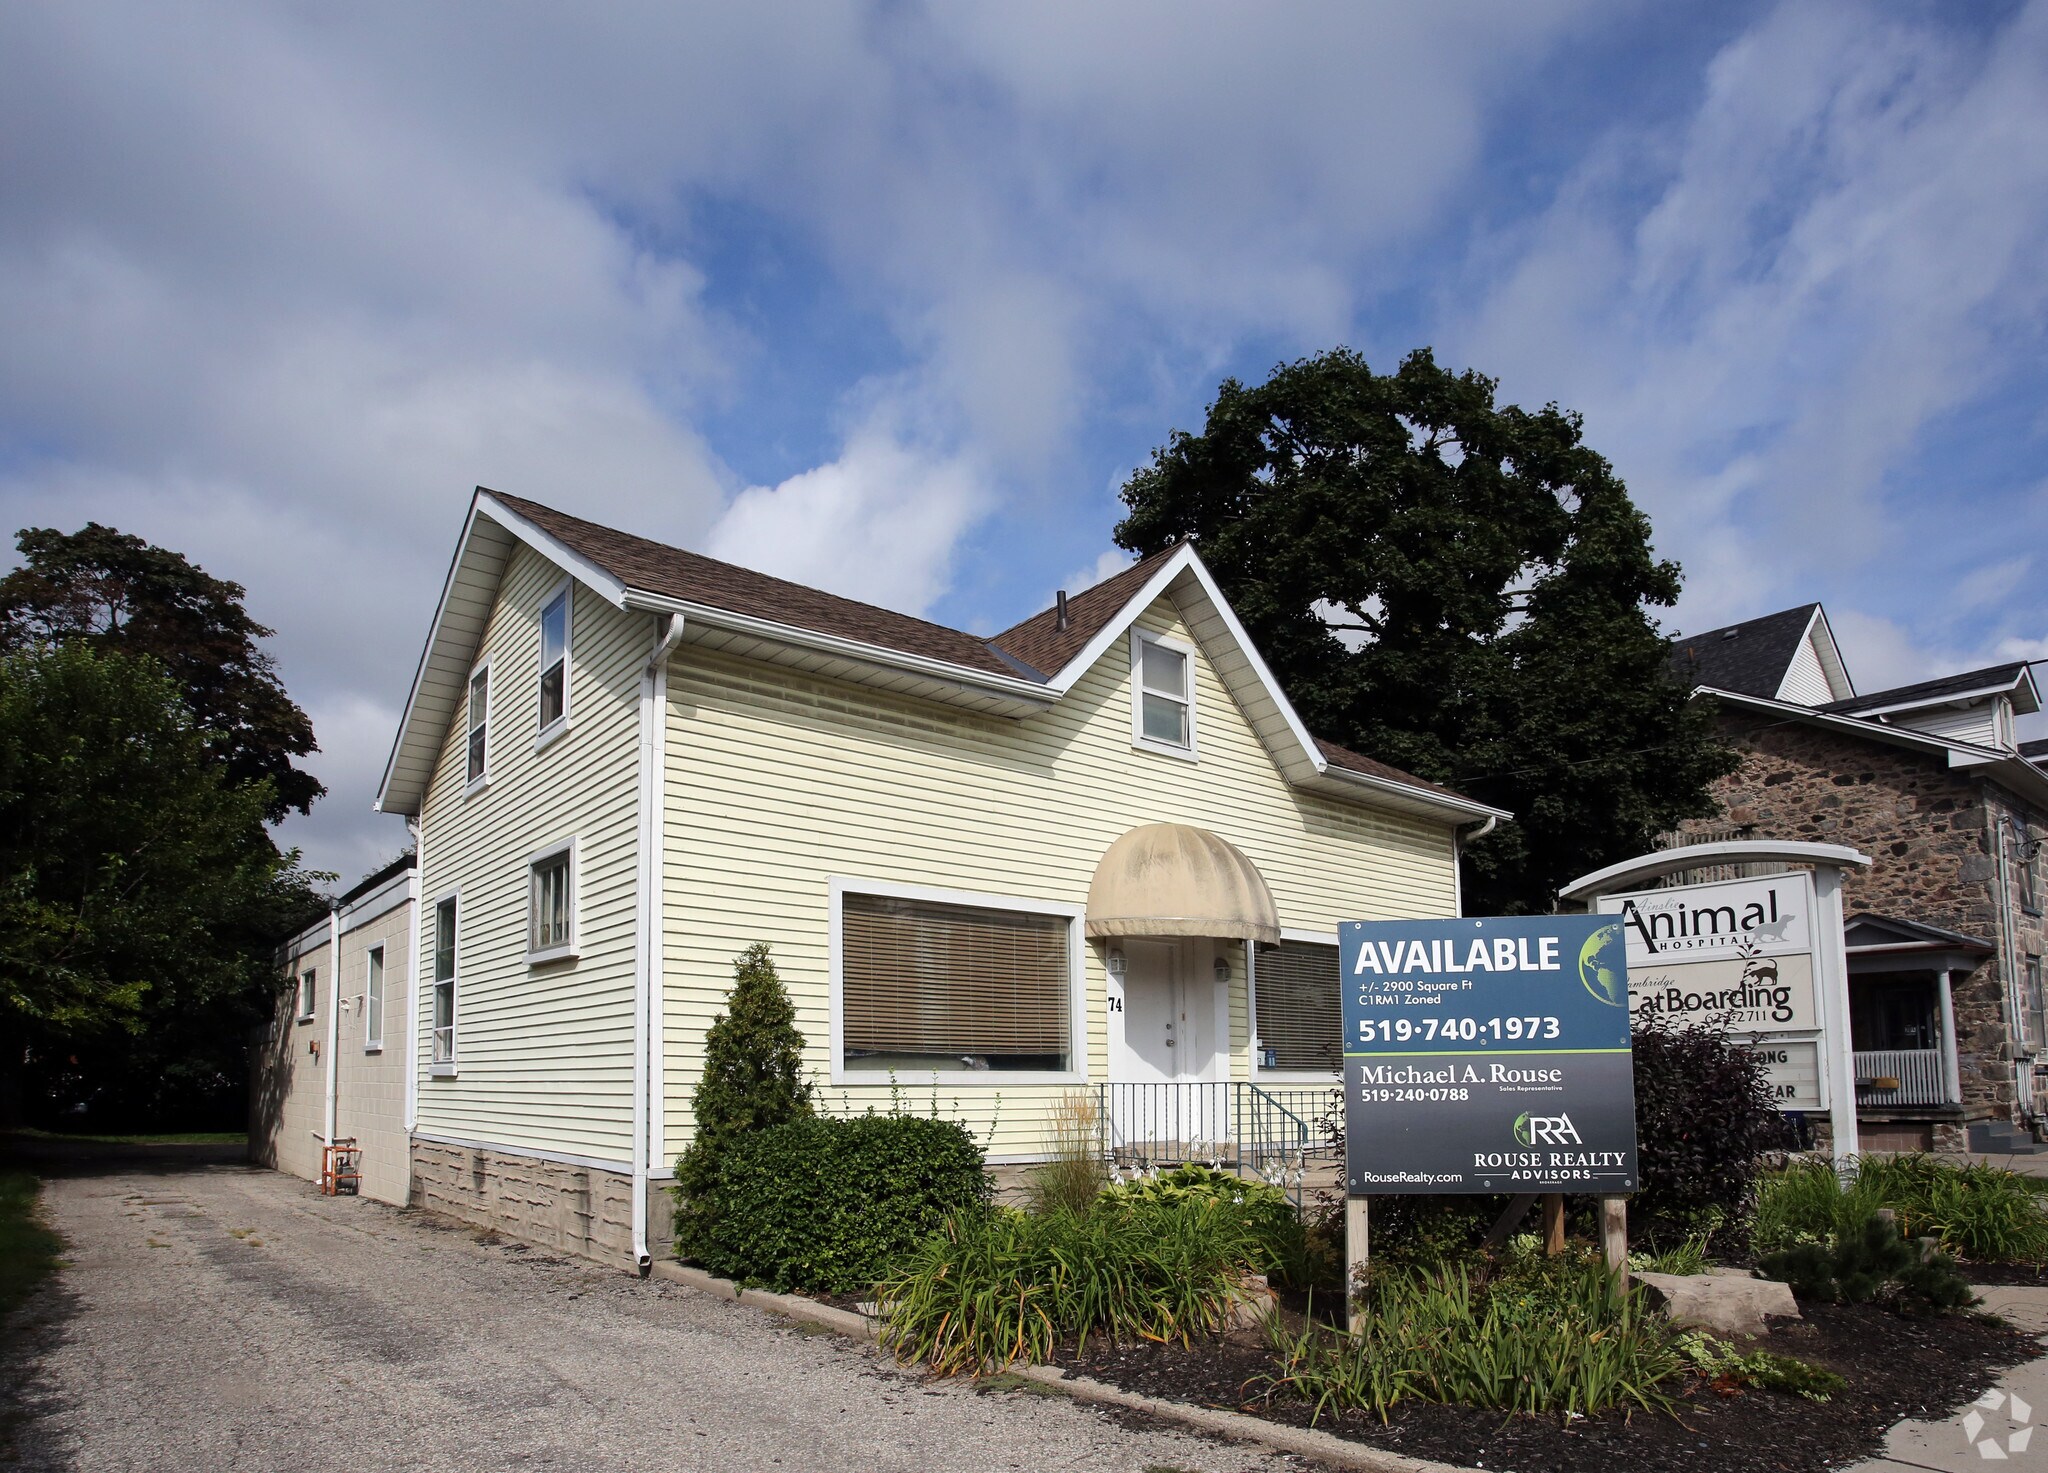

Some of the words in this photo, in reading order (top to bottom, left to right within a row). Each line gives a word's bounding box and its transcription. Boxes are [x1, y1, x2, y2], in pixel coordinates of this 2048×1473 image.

[1622, 889, 1777, 954] Animal
[1660, 935, 1750, 951] HOSPITAL
[1354, 937, 1561, 975] AVAILABLE
[1359, 983, 1379, 993] +/-
[1383, 981, 1413, 992] 2900
[1417, 980, 1458, 993] Square
[1461, 979, 1473, 991] Ft
[1627, 975, 1676, 991] ambridge
[1108, 997, 1122, 1012] 74
[1358, 995, 1400, 1005] C1RM1
[1404, 994, 1441, 1005] Zoned
[1361, 1065, 1456, 1085] Michael
[1460, 1064, 1486, 1083] A.
[1489, 1063, 1562, 1083] Rouse
[1529, 1112, 1583, 1145] RRA
[1474, 1152, 1542, 1167] ROUSE
[1549, 1152, 1626, 1167] REALTY
[1364, 1171, 1463, 1186] RouseRealty.com
[1511, 1169, 1591, 1180] ADVISORS
